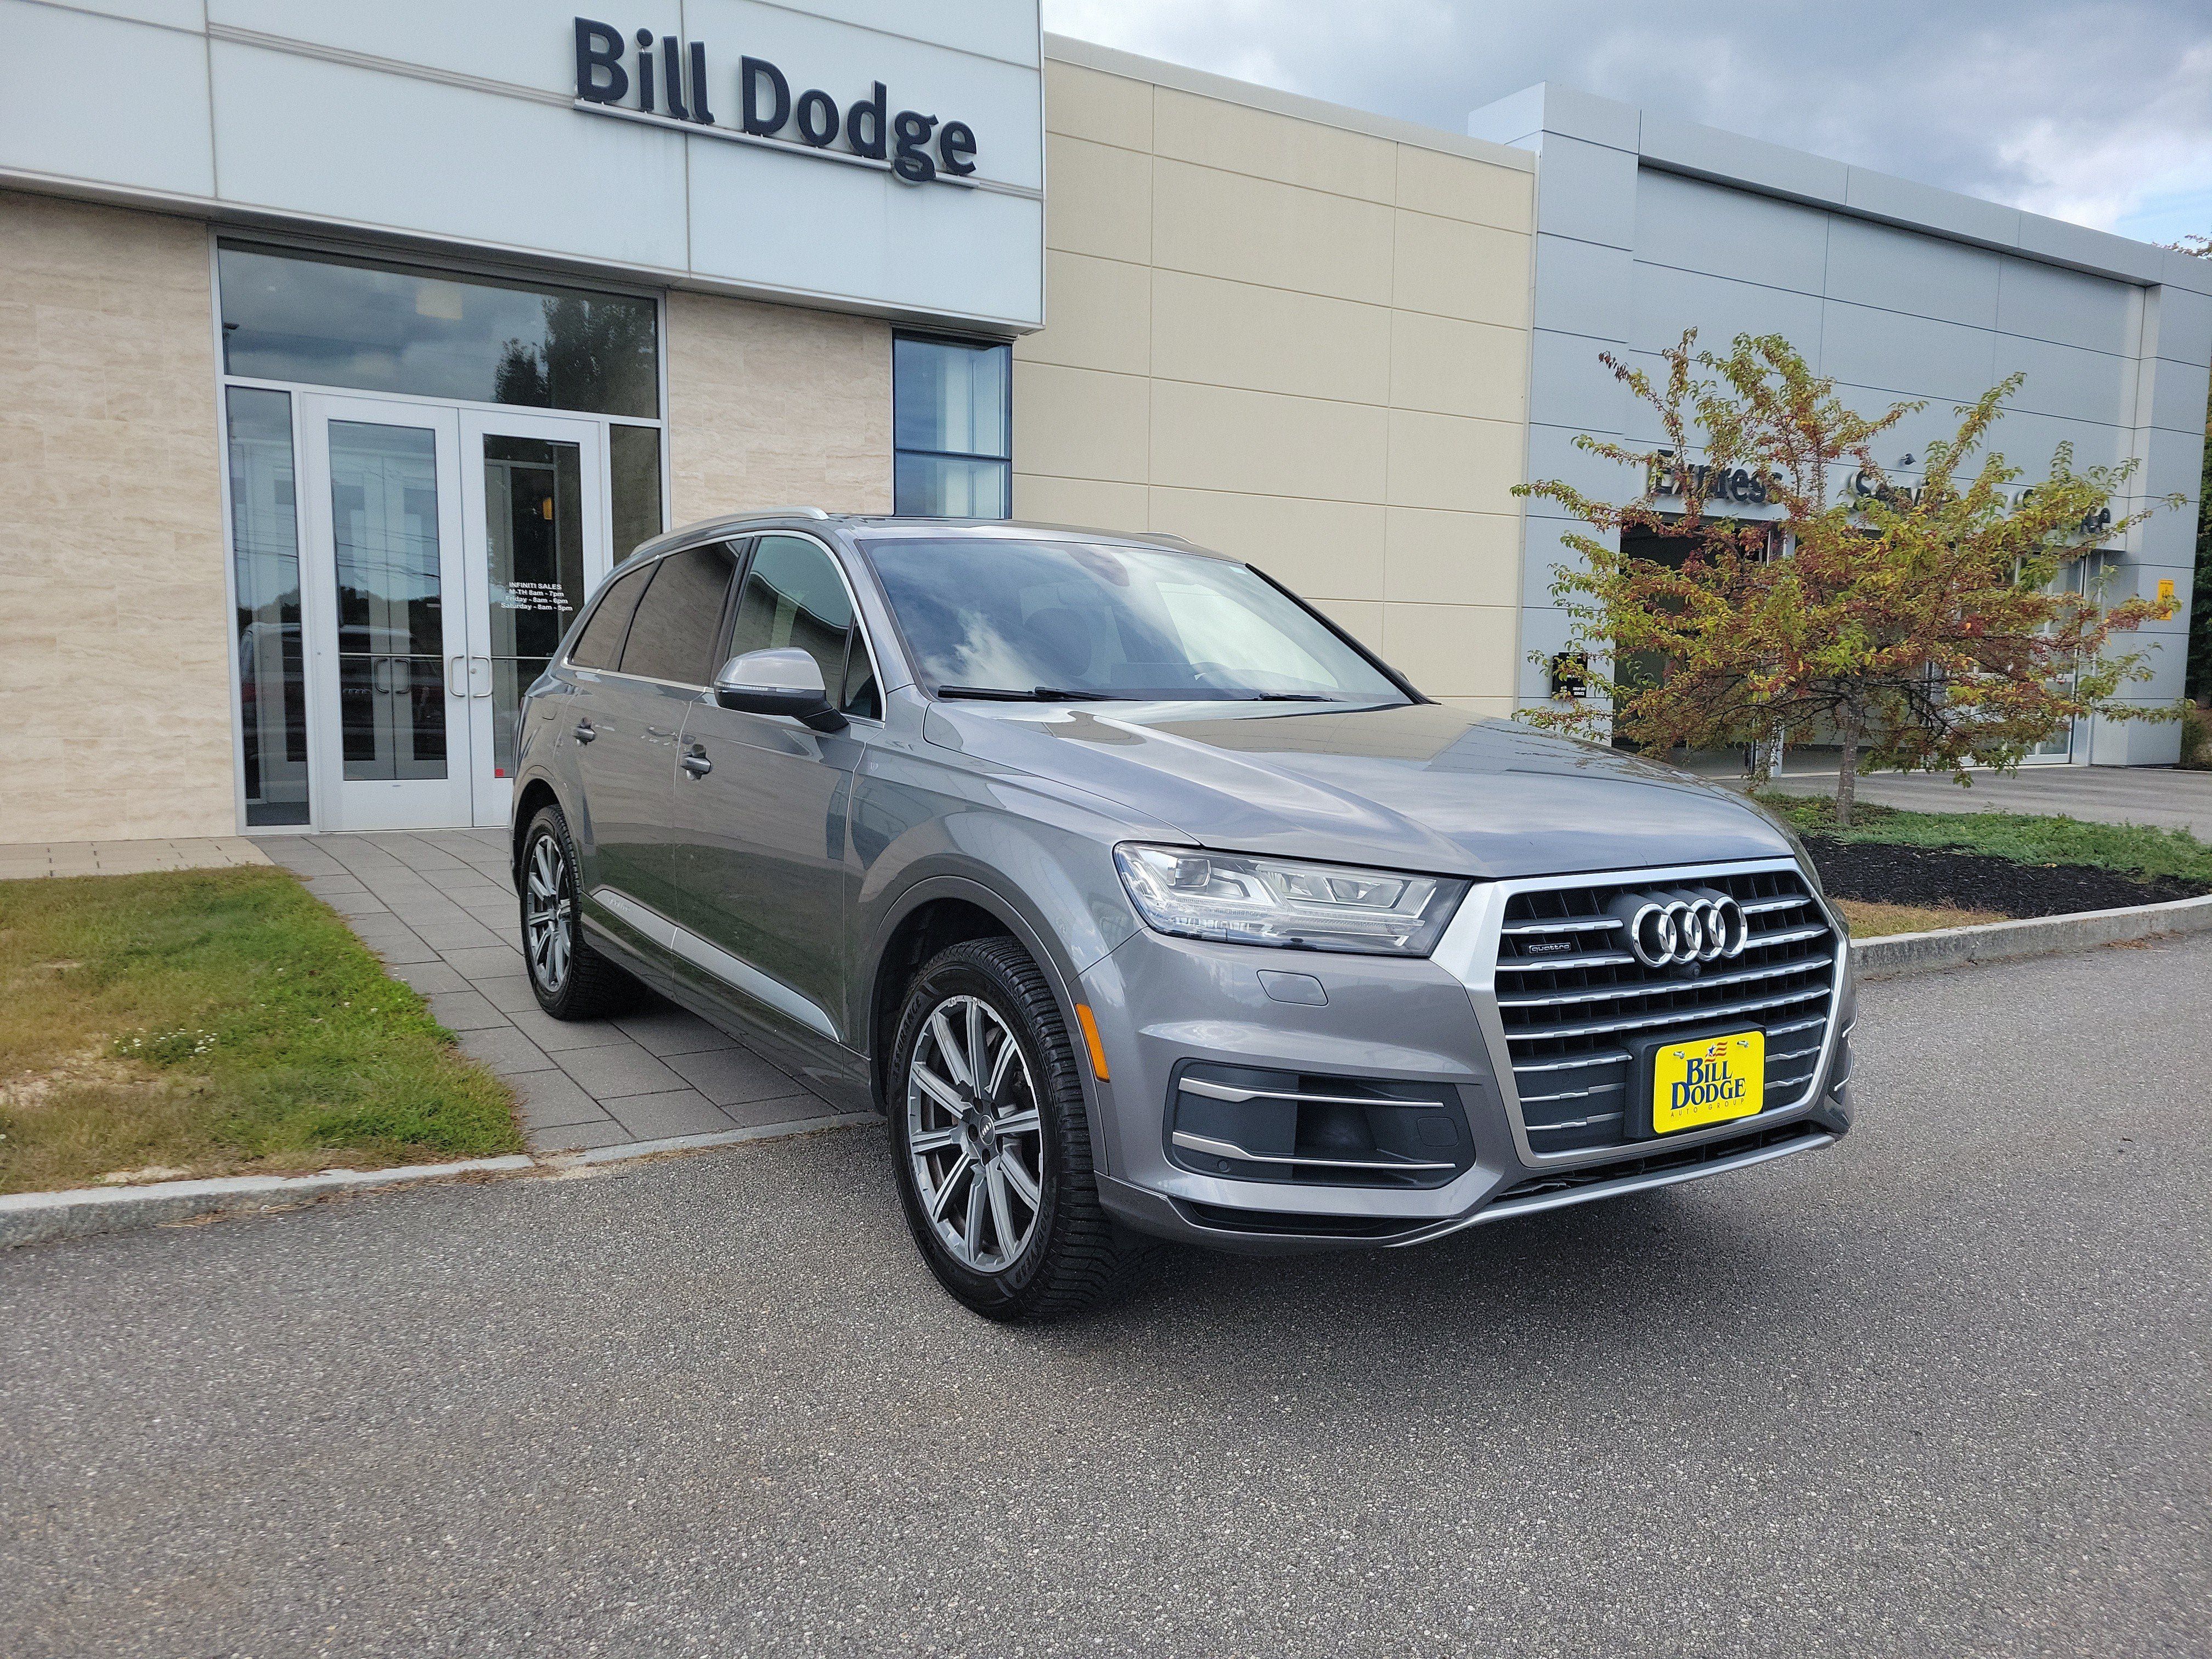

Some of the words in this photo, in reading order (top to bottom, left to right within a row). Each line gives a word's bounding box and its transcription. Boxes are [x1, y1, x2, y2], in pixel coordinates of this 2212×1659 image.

[573, 16, 715, 125] Bill
[738, 55, 977, 184] Dodge
[501, 602, 532, 611] Saturday
[1532, 944, 1570, 953] quattro
[892, 995, 921, 1082] ASSURANCE
[1686, 1058, 1733, 1086] BILL
[1671, 1077, 1746, 1110] DODGE
[1671, 1107, 1698, 1117] AUTO
[1708, 1099, 1744, 1110] GROUP
